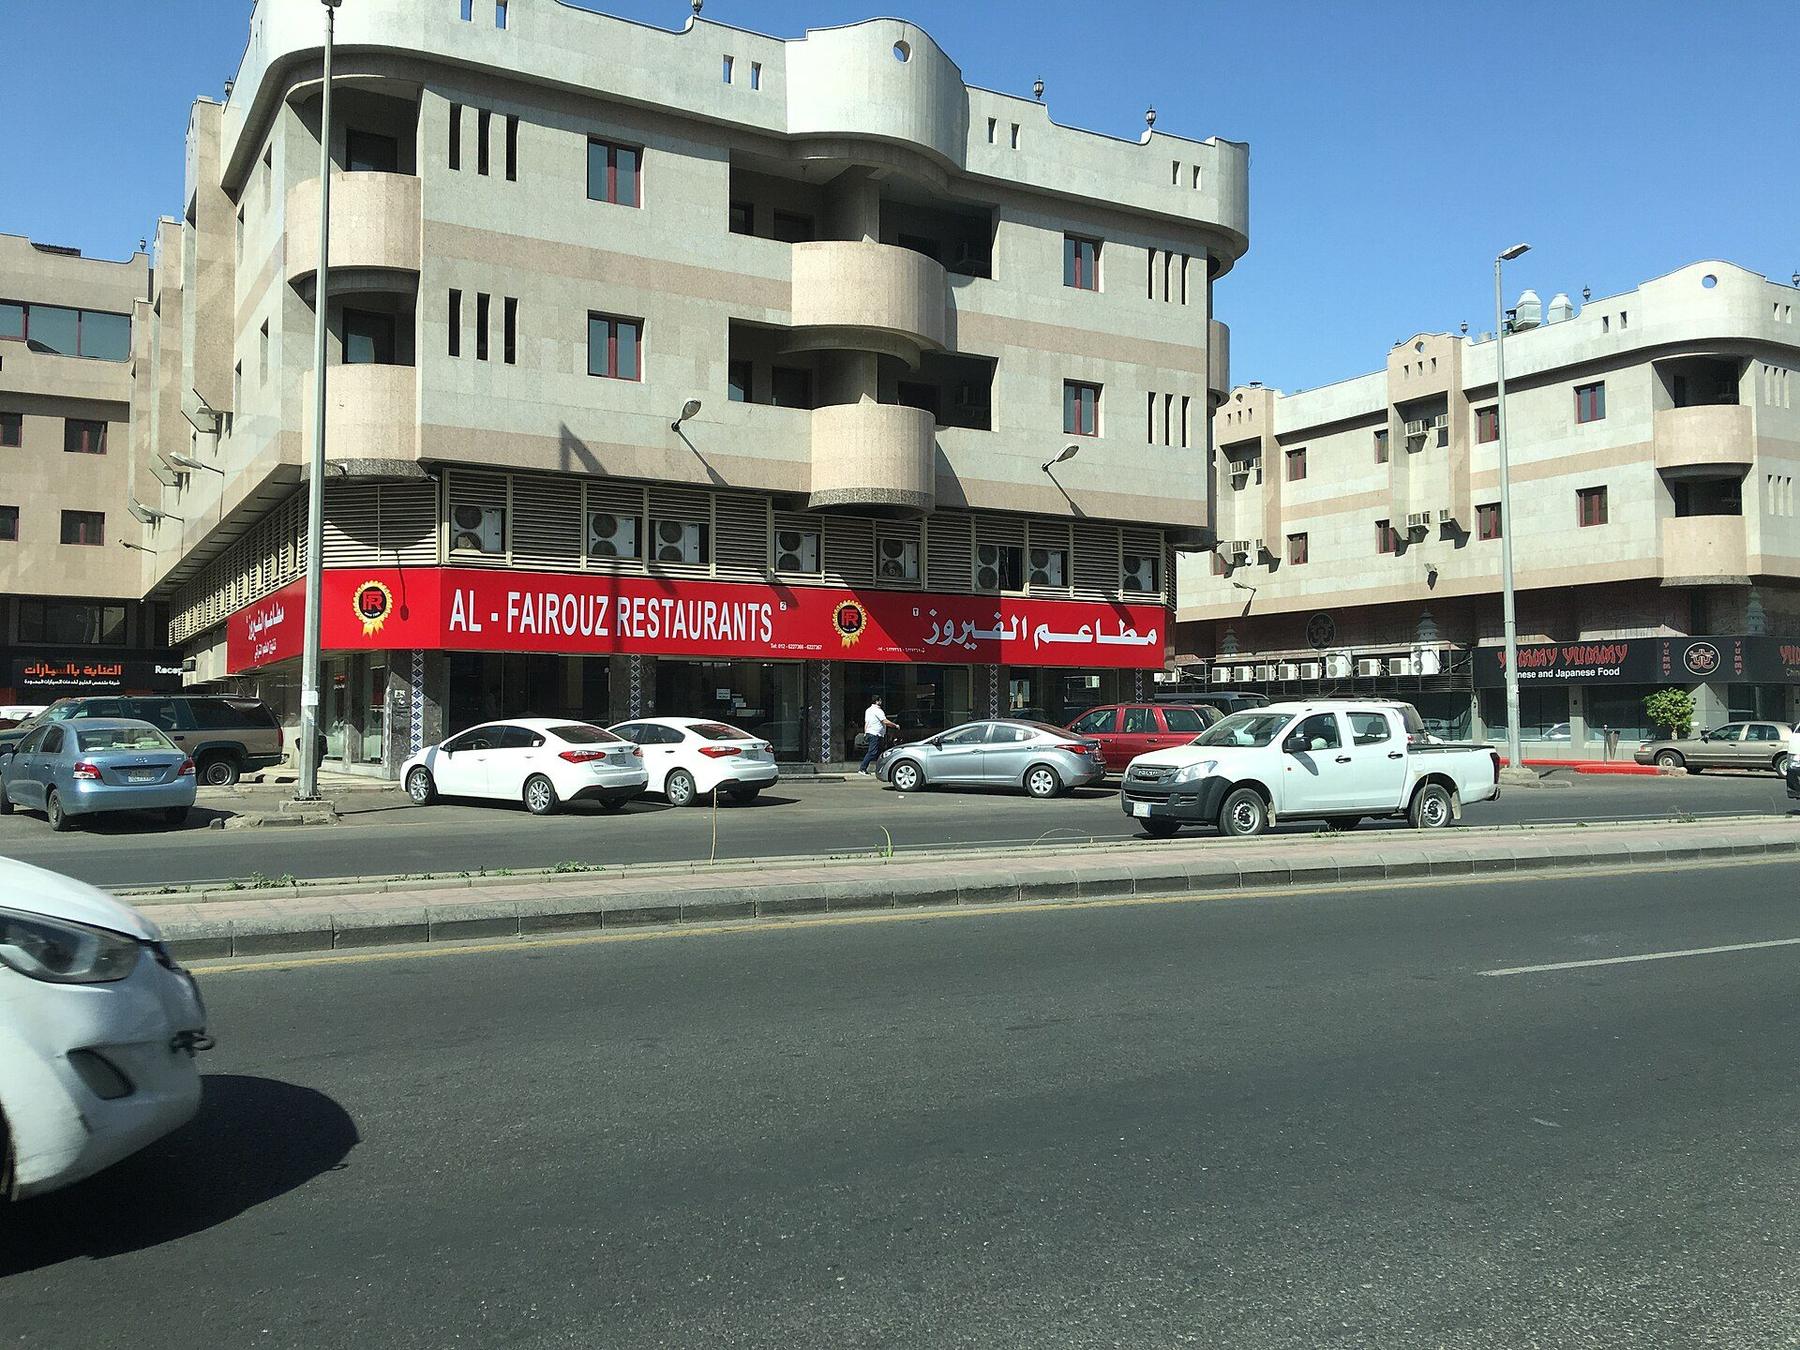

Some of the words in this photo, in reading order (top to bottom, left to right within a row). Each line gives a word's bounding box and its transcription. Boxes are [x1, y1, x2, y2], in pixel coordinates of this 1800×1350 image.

[449, 588, 481, 632] AL
[491, 613, 498, 621] -
[507, 592, 608, 636] FAIROUZ
[617, 596, 772, 643] RESTAURANTS
[922, 608, 1028, 650] الفيروز
[1034, 618, 1157, 650] مطاعم
[84, 664, 121, 676] العناية
[1497, 648, 1558, 669] YMMY
[1562, 644, 1628, 666] YUMMY
[1538, 669, 1554, 678] and
[1555, 668, 1595, 680] Japanese
[1598, 667, 1619, 676] Food
